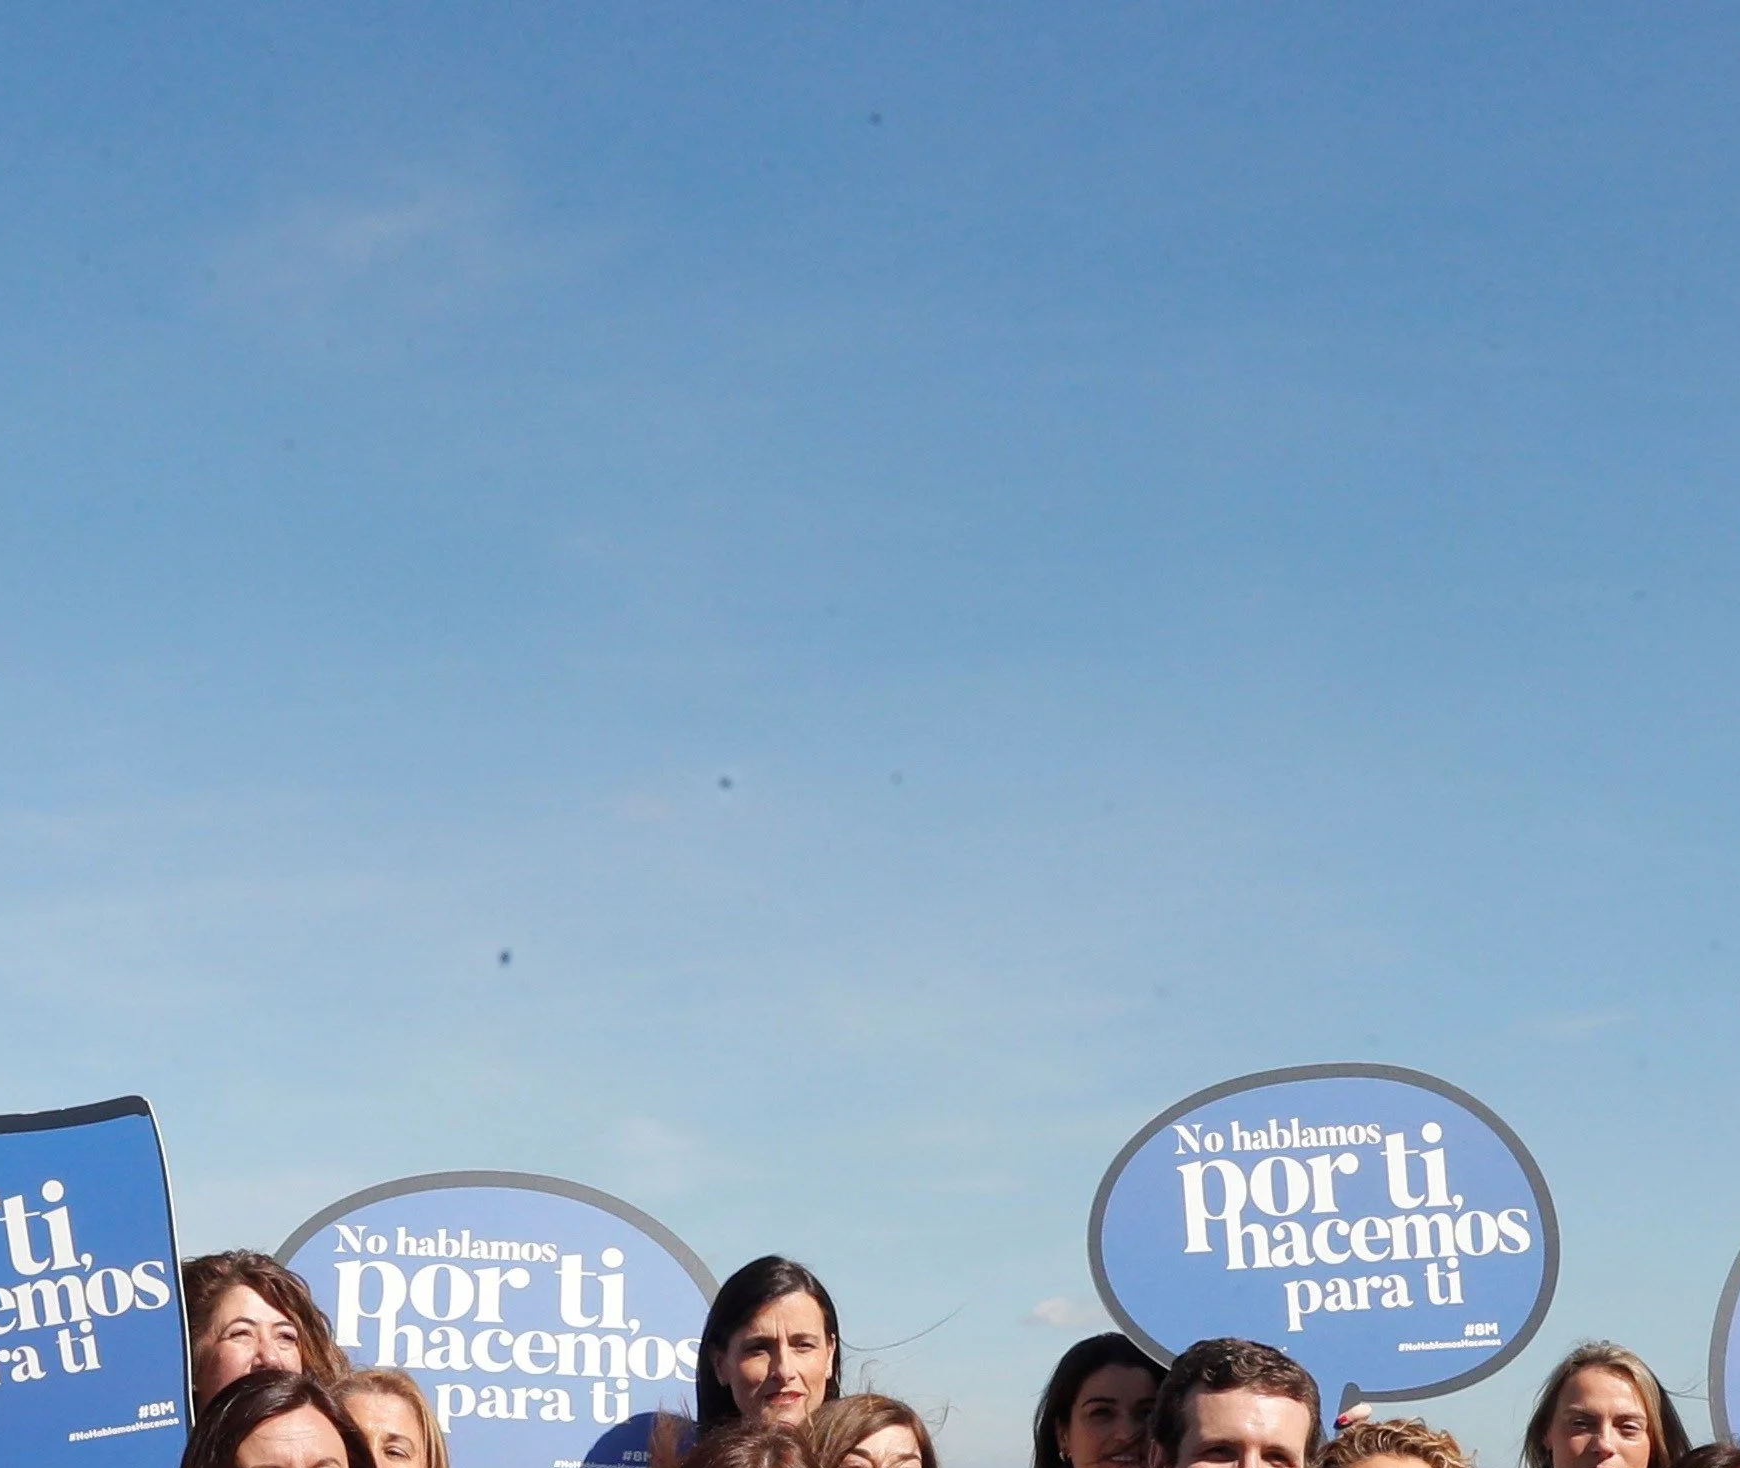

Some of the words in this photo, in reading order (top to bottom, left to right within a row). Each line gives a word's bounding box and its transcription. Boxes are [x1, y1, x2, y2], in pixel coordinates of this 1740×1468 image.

[1173, 1123, 1224, 1155] No
[1231, 1118, 1381, 1153] hablamos
[1177, 1152, 1359, 1254] por
[1381, 1122, 1464, 1212] ti,
[334, 1224, 388, 1255] No
[396, 1227, 557, 1264] hablamos
[1226, 1205, 1531, 1270] hacemos
[333, 1259, 531, 1349] por
[554, 1246, 641, 1334] ti,
[1284, 1274, 1413, 1332] para
[1425, 1256, 1464, 1305] ti
[55, 1321, 102, 1375] ti
[374, 1316, 701, 1383] hacemos
[1398, 1338, 1502, 1352] #NoHablamosHacemos
[1464, 1323, 1499, 1337] #8M
[69, 1417, 180, 1442] #NoHablamosHacemos
[138, 1401, 176, 1420] #8M
[436, 1381, 576, 1434] para
[590, 1378, 630, 1425] ti
